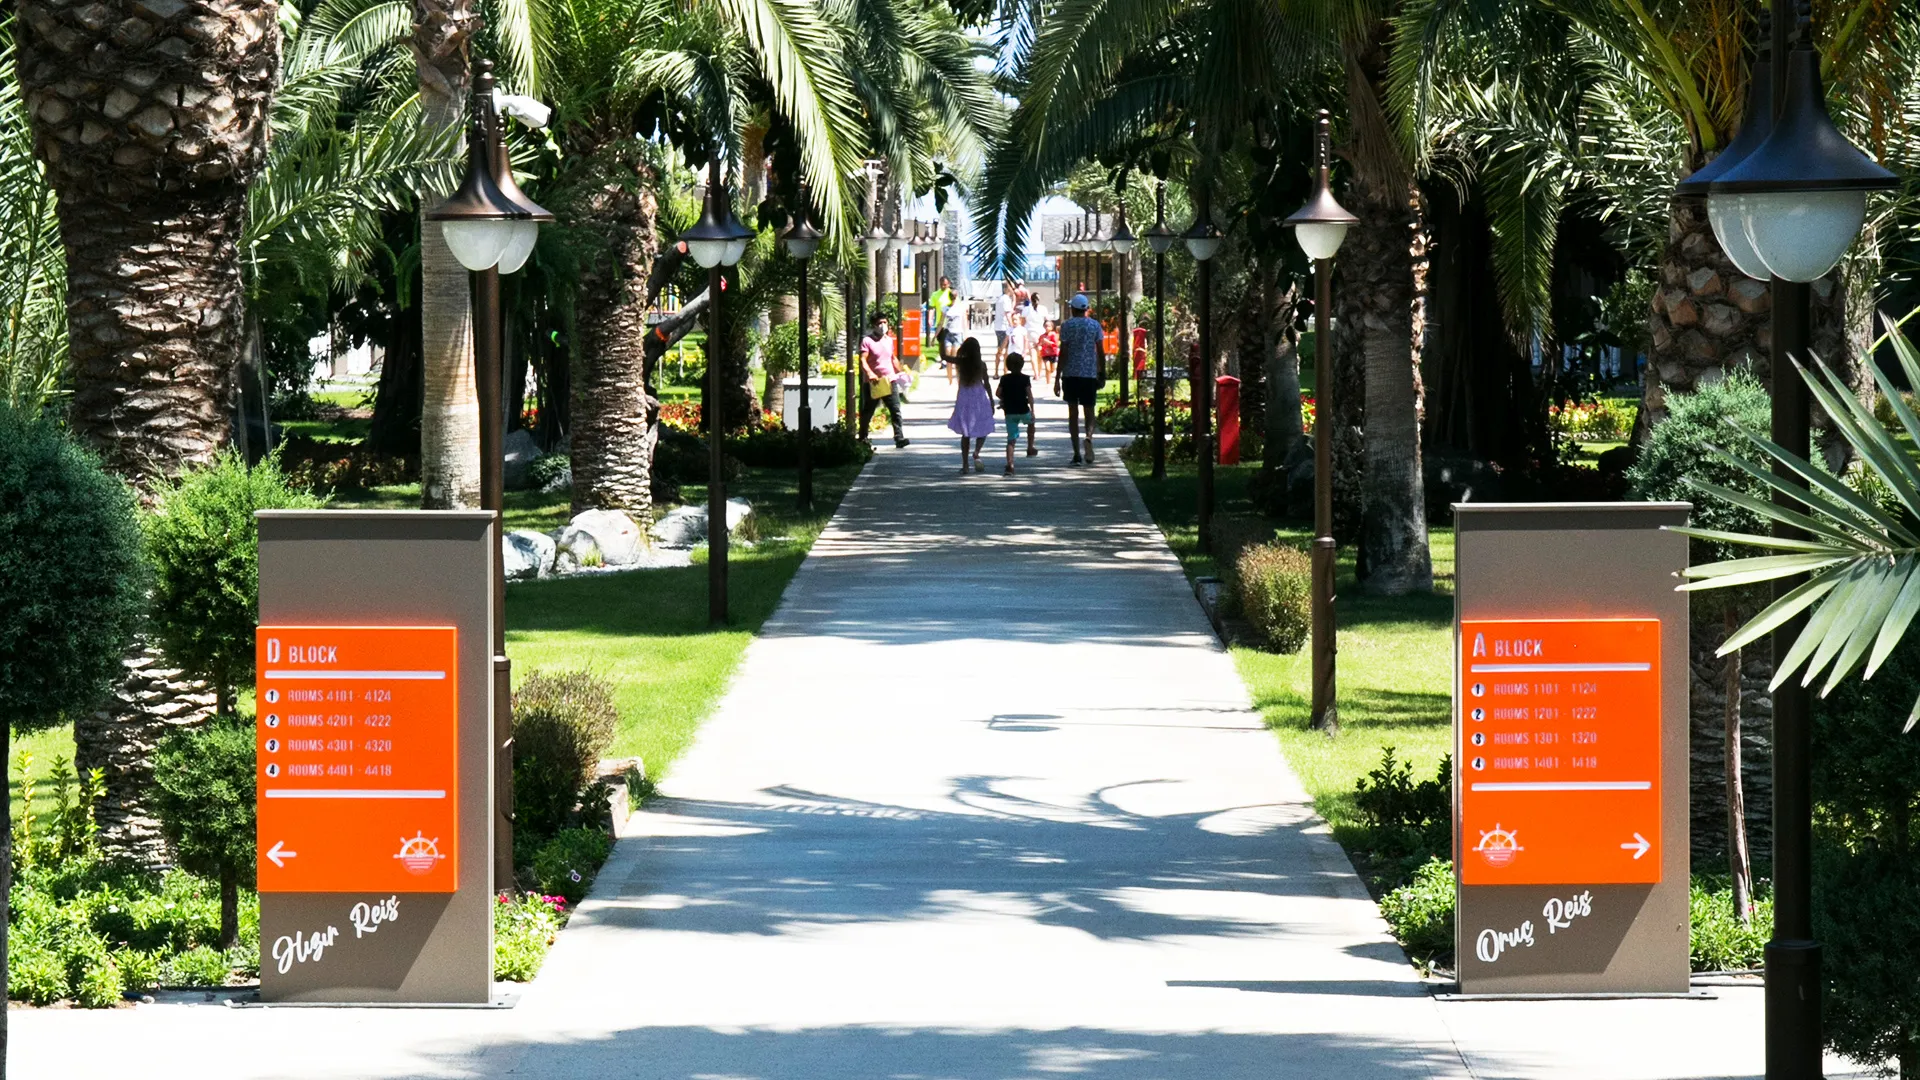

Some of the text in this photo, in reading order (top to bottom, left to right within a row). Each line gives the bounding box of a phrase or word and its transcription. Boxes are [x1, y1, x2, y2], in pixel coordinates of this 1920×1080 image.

[267, 637, 338, 663] D BLOCK
[1472, 632, 1544, 657] A BLOCK
[1493, 683, 1529, 695] ROOMS
[1534, 683, 1559, 694] 1101
[1571, 682, 1597, 694] 1124
[288, 689, 324, 702] ROOMS
[326, 689, 353, 702] 4101
[364, 689, 392, 702] 4124
[1493, 707, 1529, 720] ROOMS
[1534, 707, 1559, 719] 1201
[1571, 706, 1597, 719] 1222
[288, 714, 324, 727] ROOMS
[326, 714, 353, 727] 4201
[364, 714, 392, 727] 4222
[1493, 732, 1529, 744] ROOMS
[1534, 732, 1559, 743] 1301
[1571, 731, 1597, 743] 1320
[288, 739, 324, 752] ROOMS
[326, 739, 353, 752] 4301
[364, 739, 392, 752] 4320
[1493, 757, 1529, 769] ROOMS
[1534, 757, 1559, 768] 1401
[1571, 756, 1597, 768] 1418
[288, 764, 324, 776] ROOMS
[326, 764, 353, 776] 4401
[364, 764, 392, 776] 4418
[349, 895, 401, 939] Reis
[1476, 889, 1594, 962] Oruç Reis
